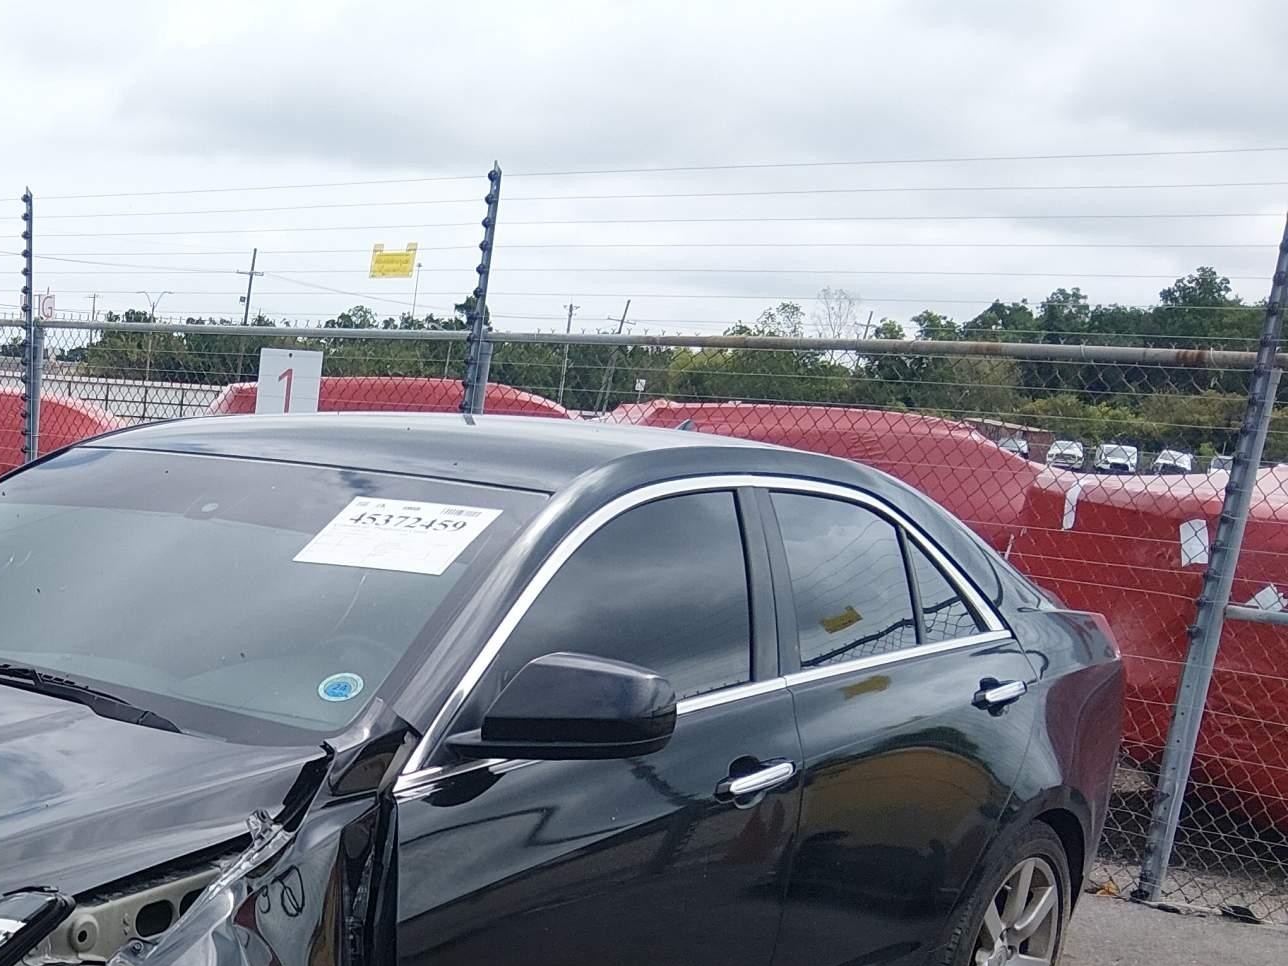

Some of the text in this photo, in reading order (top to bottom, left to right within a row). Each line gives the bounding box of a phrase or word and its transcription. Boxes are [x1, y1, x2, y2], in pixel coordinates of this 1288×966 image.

[42, 296, 53, 318] G
[278, 368, 293, 414] 1
[349, 511, 468, 532] 45372459
